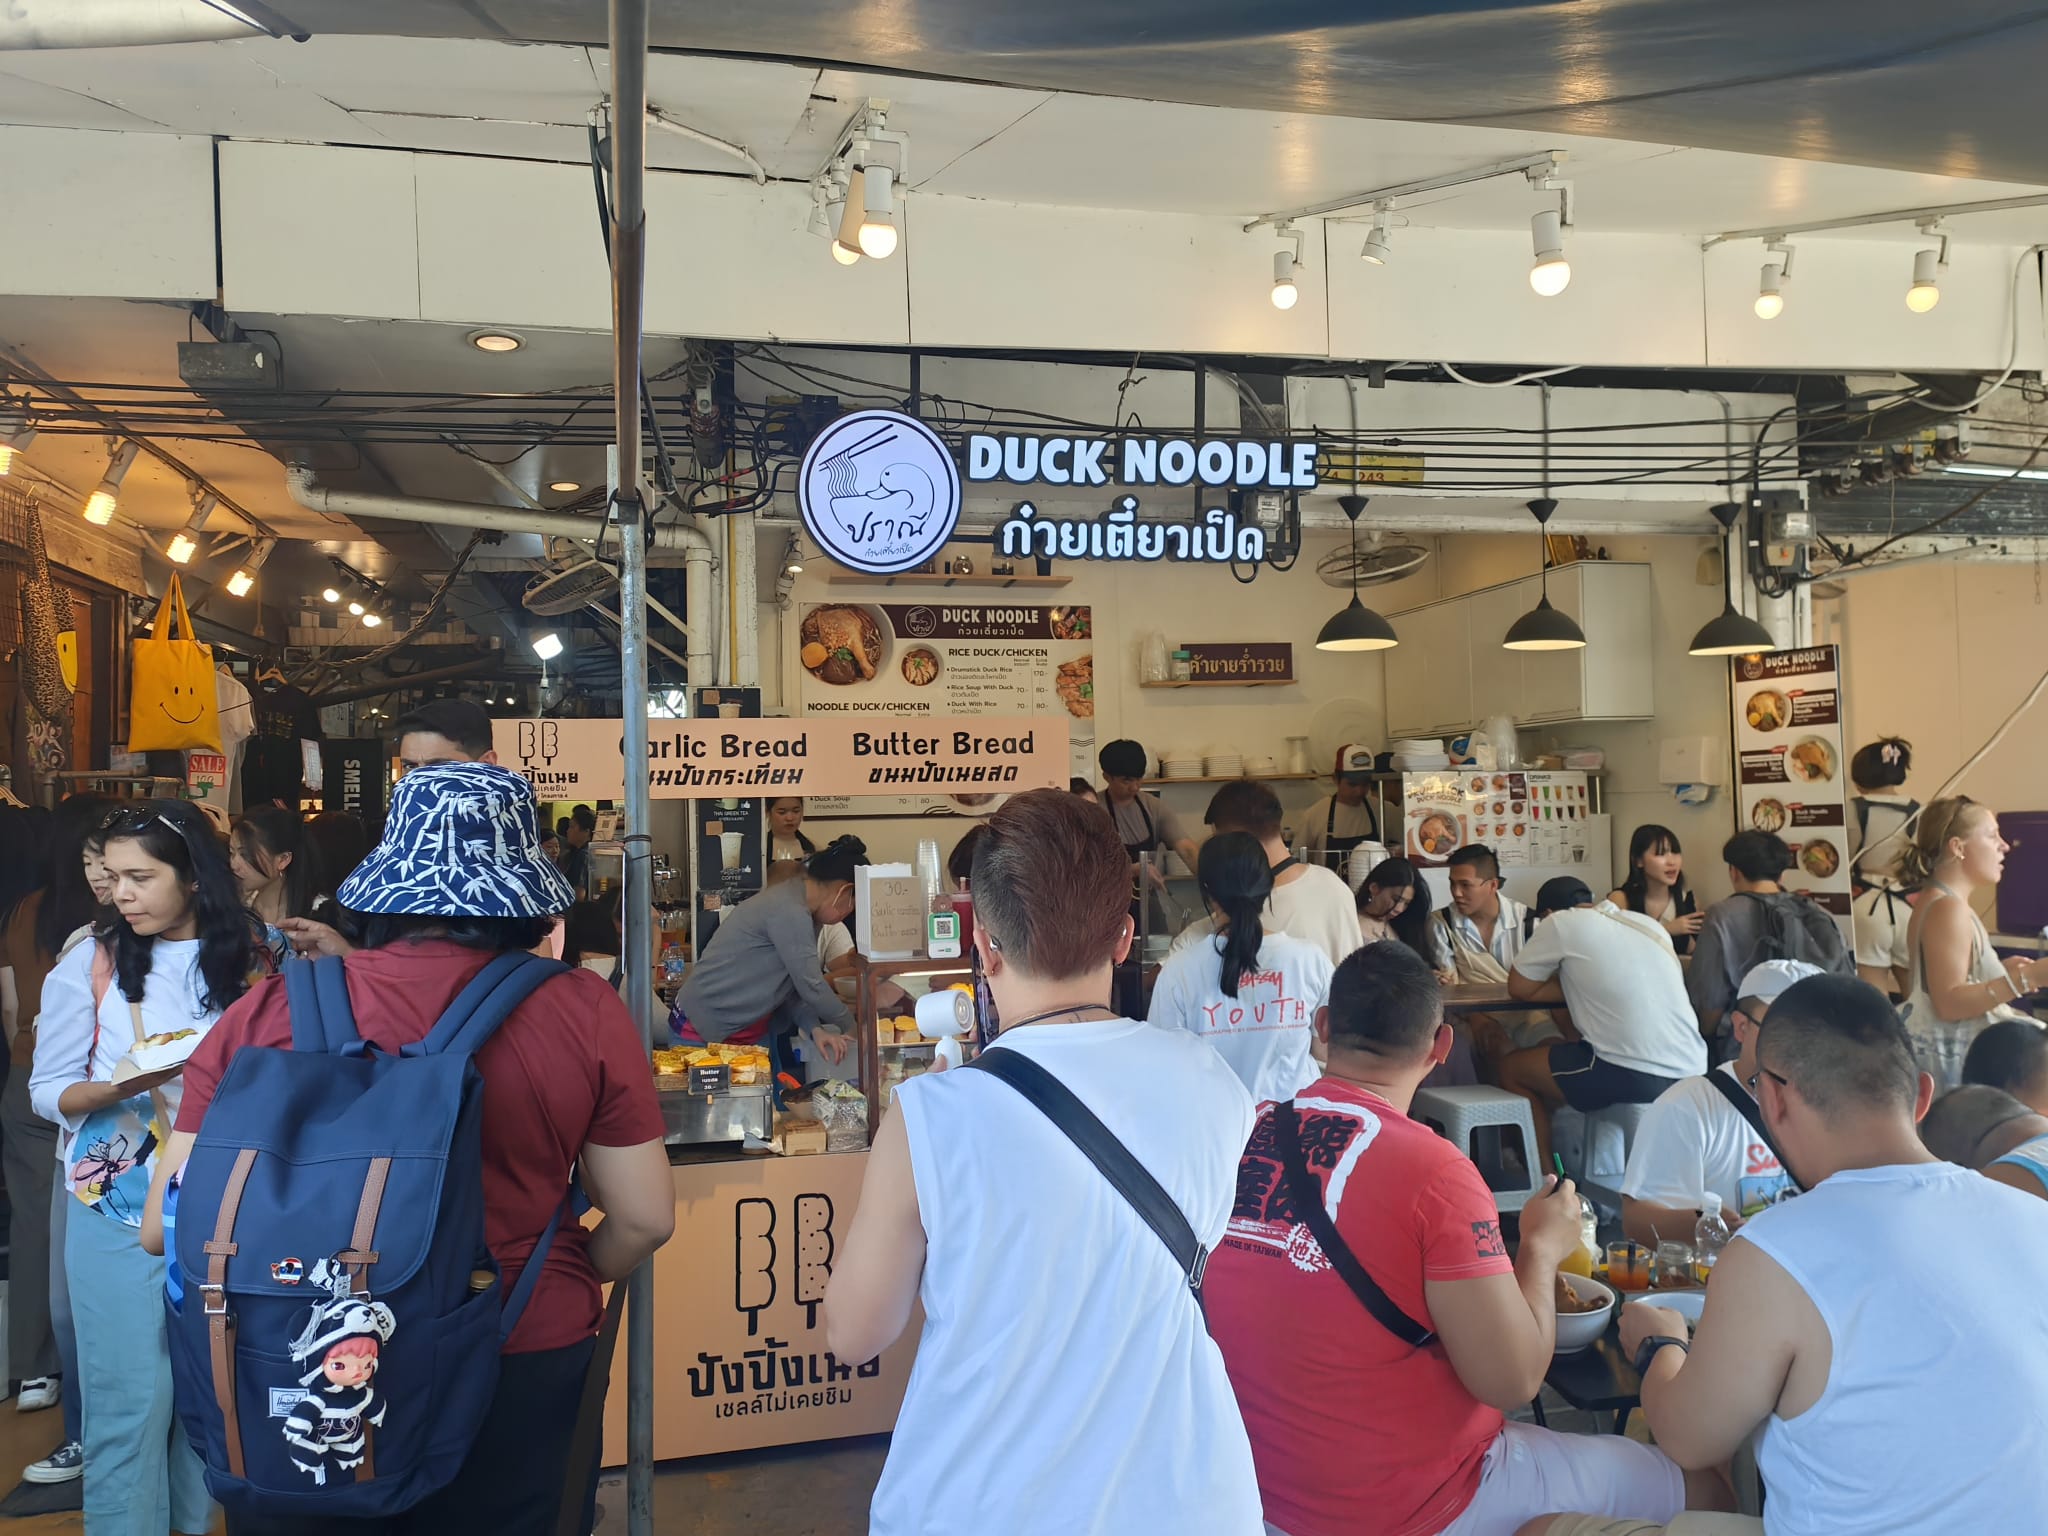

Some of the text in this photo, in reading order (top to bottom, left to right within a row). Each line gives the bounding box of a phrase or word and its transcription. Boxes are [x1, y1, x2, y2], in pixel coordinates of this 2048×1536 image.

[967, 434, 1317, 487] DUCK NOODLE
[1002, 497, 1264, 561] ก๋วยเตี๋ยวเป็ด
[942, 608, 1040, 625] DUCK NOODLE
[948, 648, 1048, 657] RICE DUCK/CHICKEN
[1765, 650, 1826, 668] DUCK NOODLE
[807, 702, 930, 711] NOODLE DUCK/CHICKEN
[618, 732, 808, 759] arlic Bread
[853, 730, 1034, 757] Butter Bread
[191, 755, 225, 772] SALE
[622, 762, 804, 786] มปังกระเทียม
[868, 760, 1019, 784] ขนมปังเนยสด
[1202, 998, 1305, 1028] YOUTH
